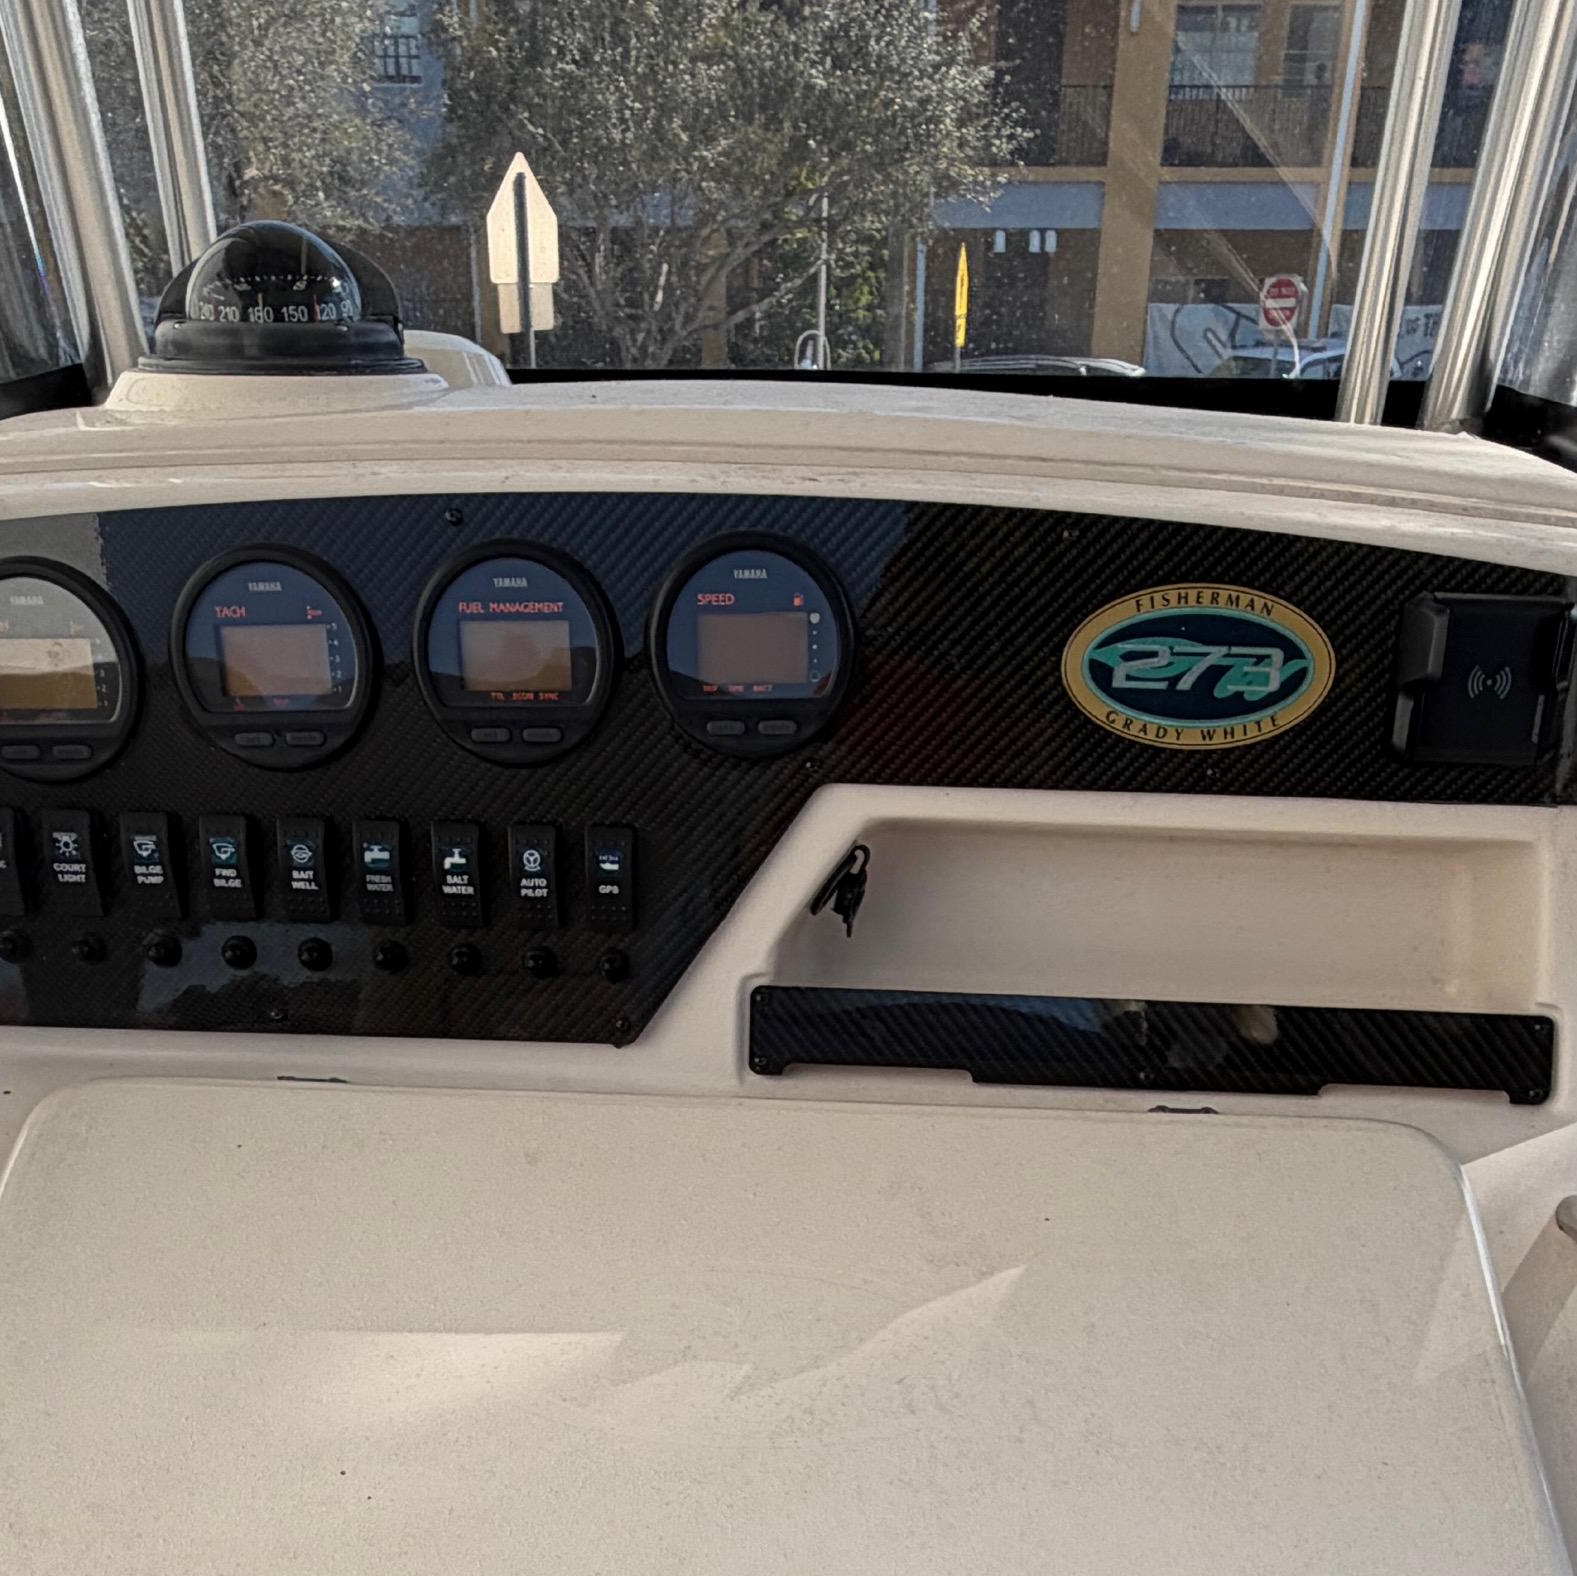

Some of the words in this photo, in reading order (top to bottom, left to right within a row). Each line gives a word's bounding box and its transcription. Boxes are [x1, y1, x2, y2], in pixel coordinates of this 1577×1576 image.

[218, 304, 241, 322] 210
[248, 305, 273, 322] 180
[281, 305, 308, 322] 150
[732, 569, 768, 579] YAMAHA
[247, 581, 283, 592] YAMAHA
[492, 577, 528, 588] YAMAHA
[696, 593, 736, 606] SPEED
[1135, 591, 1274, 616] FISHERMAN
[214, 606, 247, 618] TACH
[458, 602, 485, 613] FUEL
[489, 601, 564, 613] MANAGEMENT
[1111, 644, 1284, 693] 273
[1106, 710, 1185, 741] GRADY
[1201, 714, 1279, 742] WHITE
[53, 863, 86, 872] COURT
[57, 873, 86, 883] LIGHT
[291, 869, 314, 879] BAIT
[136, 875, 165, 884] PUMP
[446, 875, 469, 884] SALT
[520, 878, 548, 888] AUTO
[290, 880, 319, 890] WELL
[442, 885, 475, 895] WATER
[598, 884, 620, 895] GPS
[520, 888, 549, 898] PILOT
